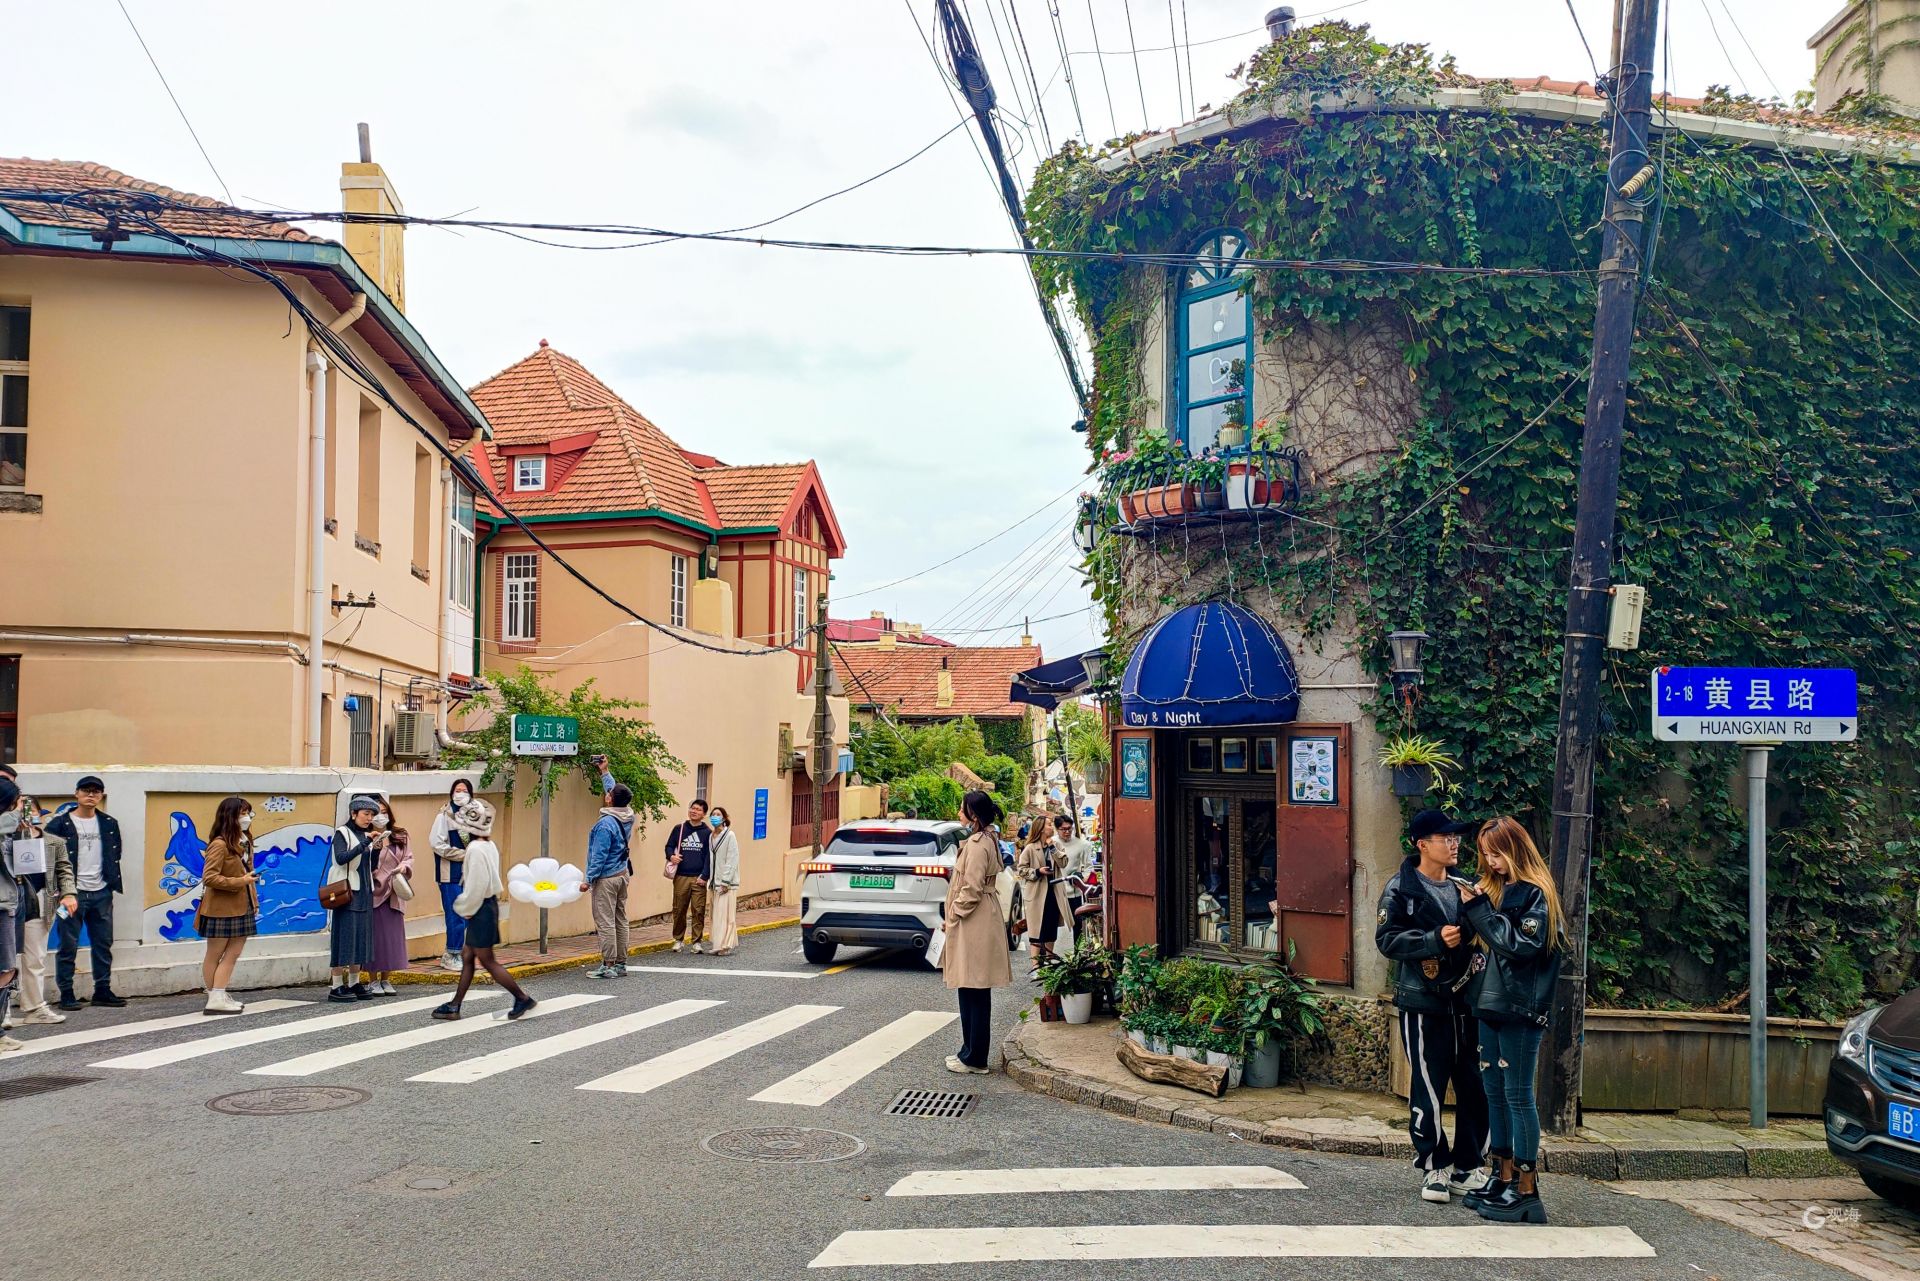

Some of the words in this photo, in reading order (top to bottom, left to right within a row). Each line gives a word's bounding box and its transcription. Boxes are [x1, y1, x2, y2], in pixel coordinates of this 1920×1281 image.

[1704, 677, 1815, 711] 黄县路
[1131, 711, 1148, 726] Day
[1151, 711, 1159, 723] &
[1165, 711, 1202, 726] Night
[529, 721, 565, 740] 龙江路
[1700, 720, 1786, 735] HUANGXIAN
[1794, 721, 1812, 735] Rd
